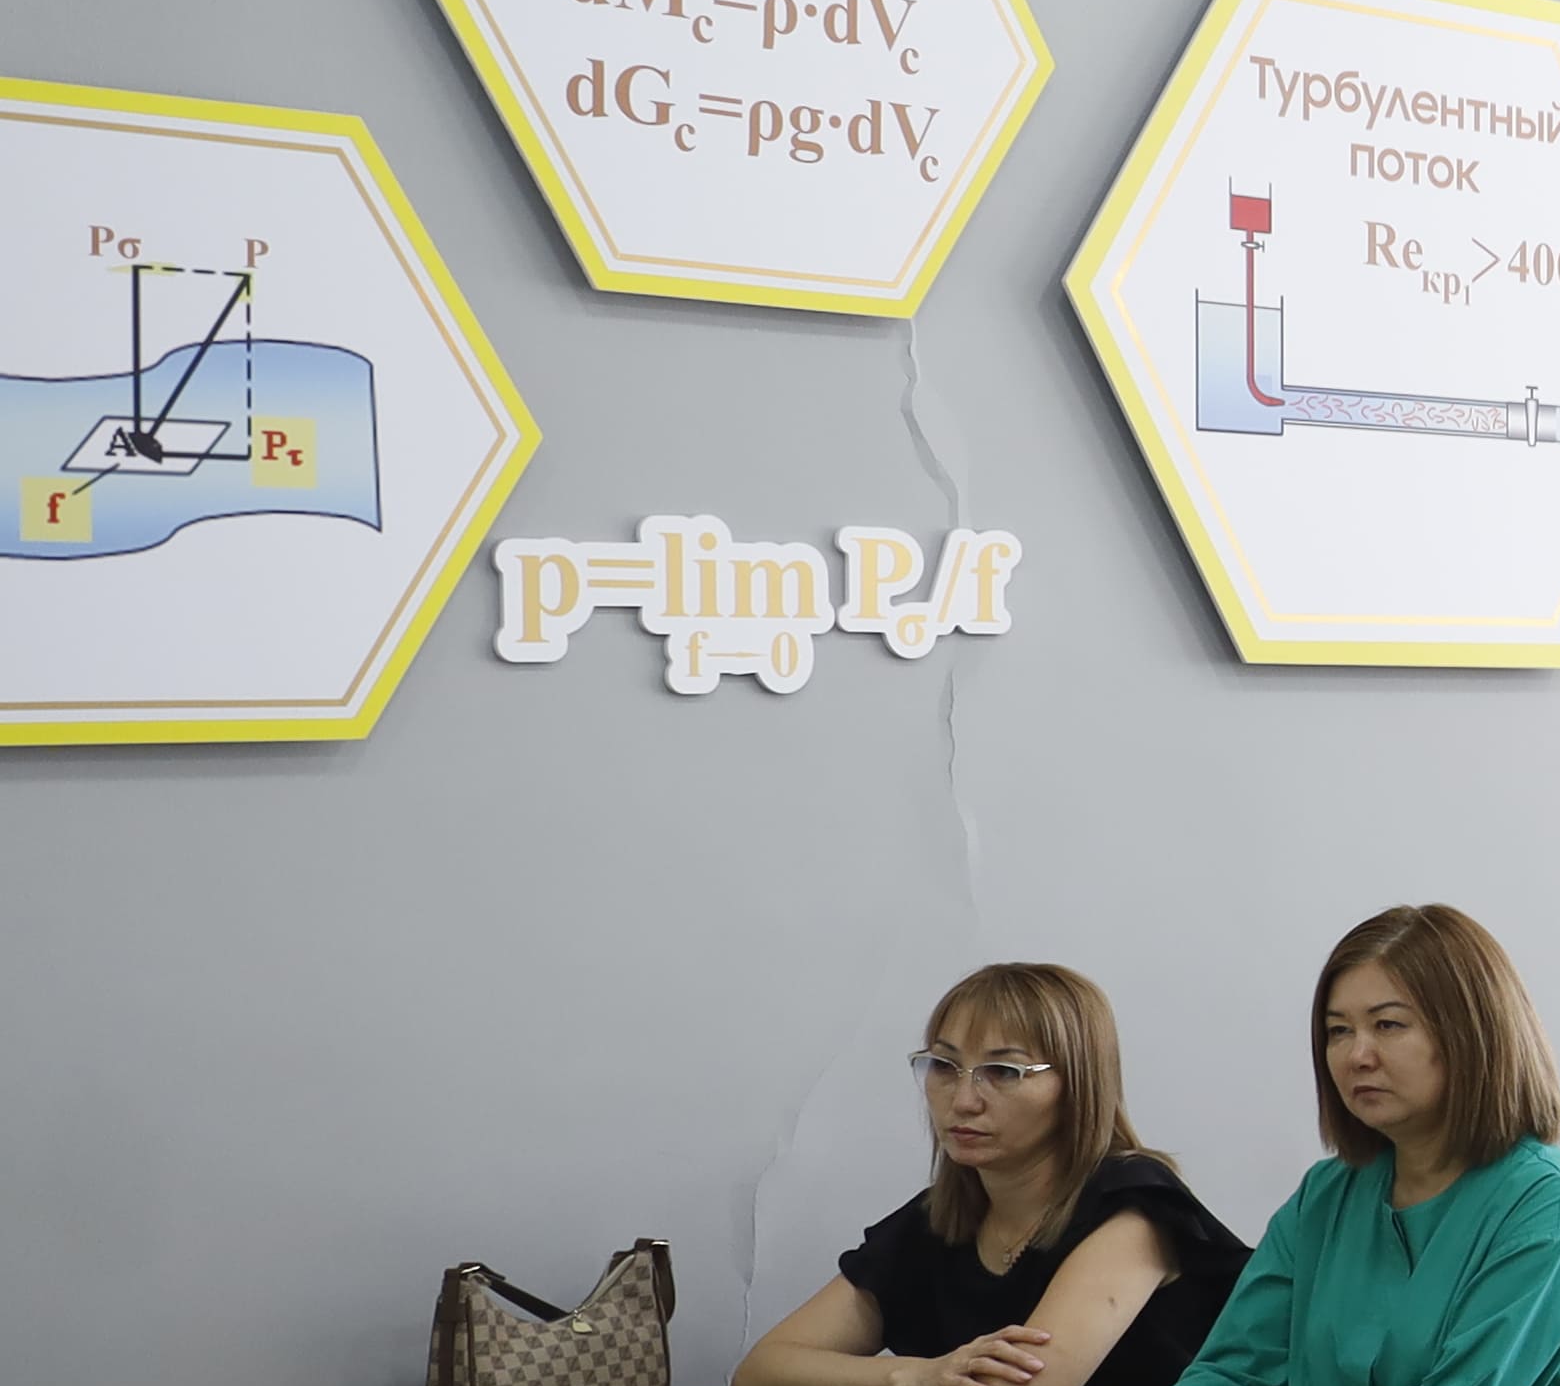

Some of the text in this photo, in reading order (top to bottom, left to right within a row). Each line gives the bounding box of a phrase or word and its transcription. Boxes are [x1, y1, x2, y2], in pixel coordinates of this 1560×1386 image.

[1350, 143, 1480, 193] поток
[246, 238, 269, 268] P
[105, 428, 136, 457] A
[47, 493, 66, 523] f
